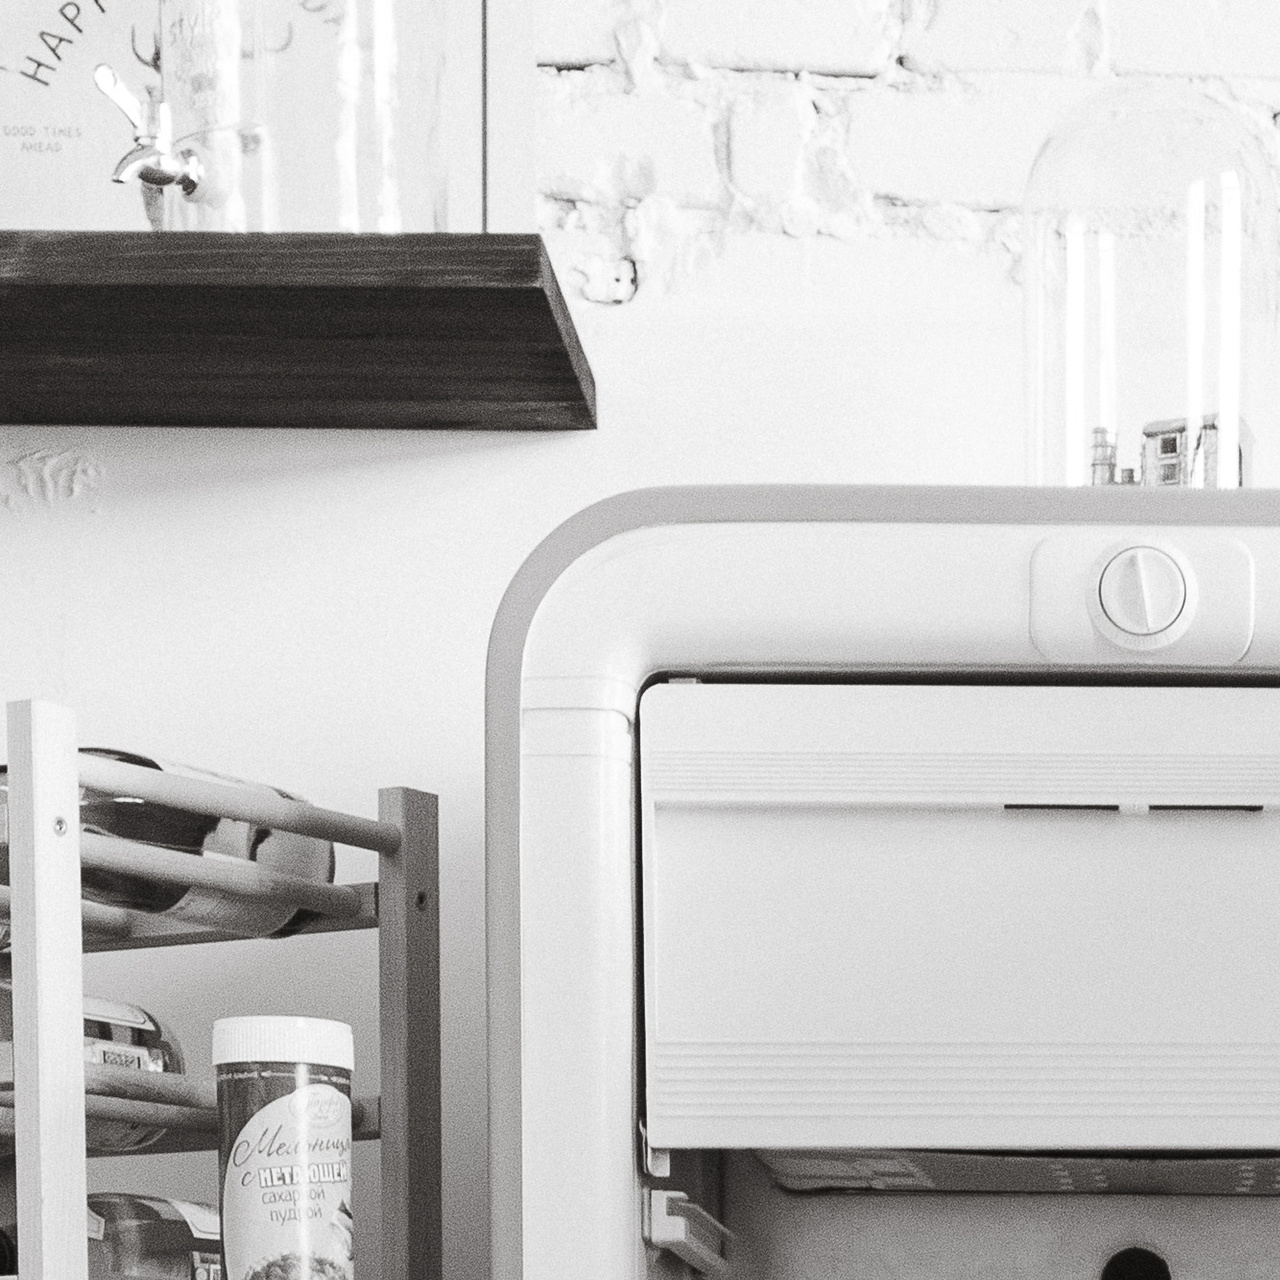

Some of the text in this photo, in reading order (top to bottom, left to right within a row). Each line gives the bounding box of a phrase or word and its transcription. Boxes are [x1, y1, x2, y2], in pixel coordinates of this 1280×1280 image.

[43, 126, 82, 138] TIMES
[231, 1123, 350, 1168] Мелниц
[261, 1185, 326, 1207] сахарой
[269, 1203, 324, 1227] пудой
